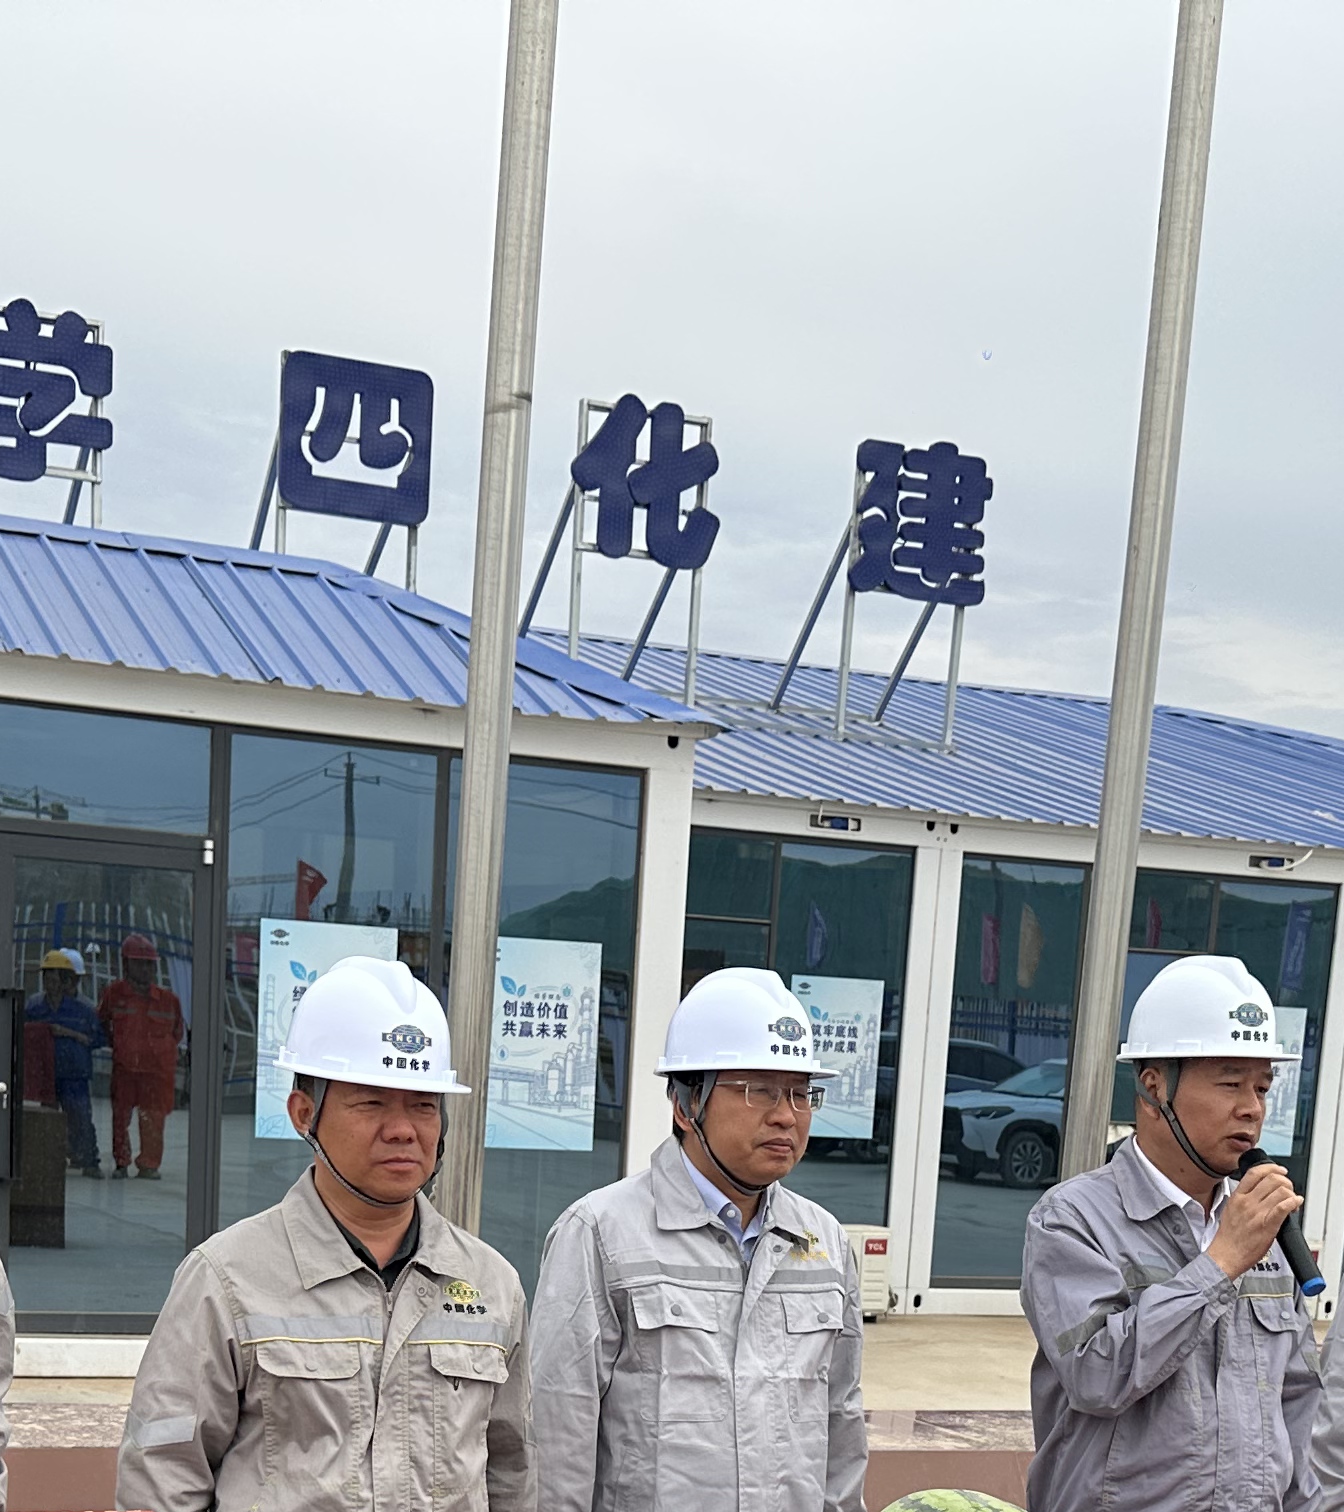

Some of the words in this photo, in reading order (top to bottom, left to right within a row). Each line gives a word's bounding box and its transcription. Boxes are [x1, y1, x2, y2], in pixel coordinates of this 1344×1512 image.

[503, 1000, 568, 1020] 创造价值
[502, 1020, 567, 1039] 共赢未来
[382, 1056, 431, 1071] 中国化学
[867, 1243, 884, 1251] TCL
[443, 1302, 487, 1315] 中国化学
